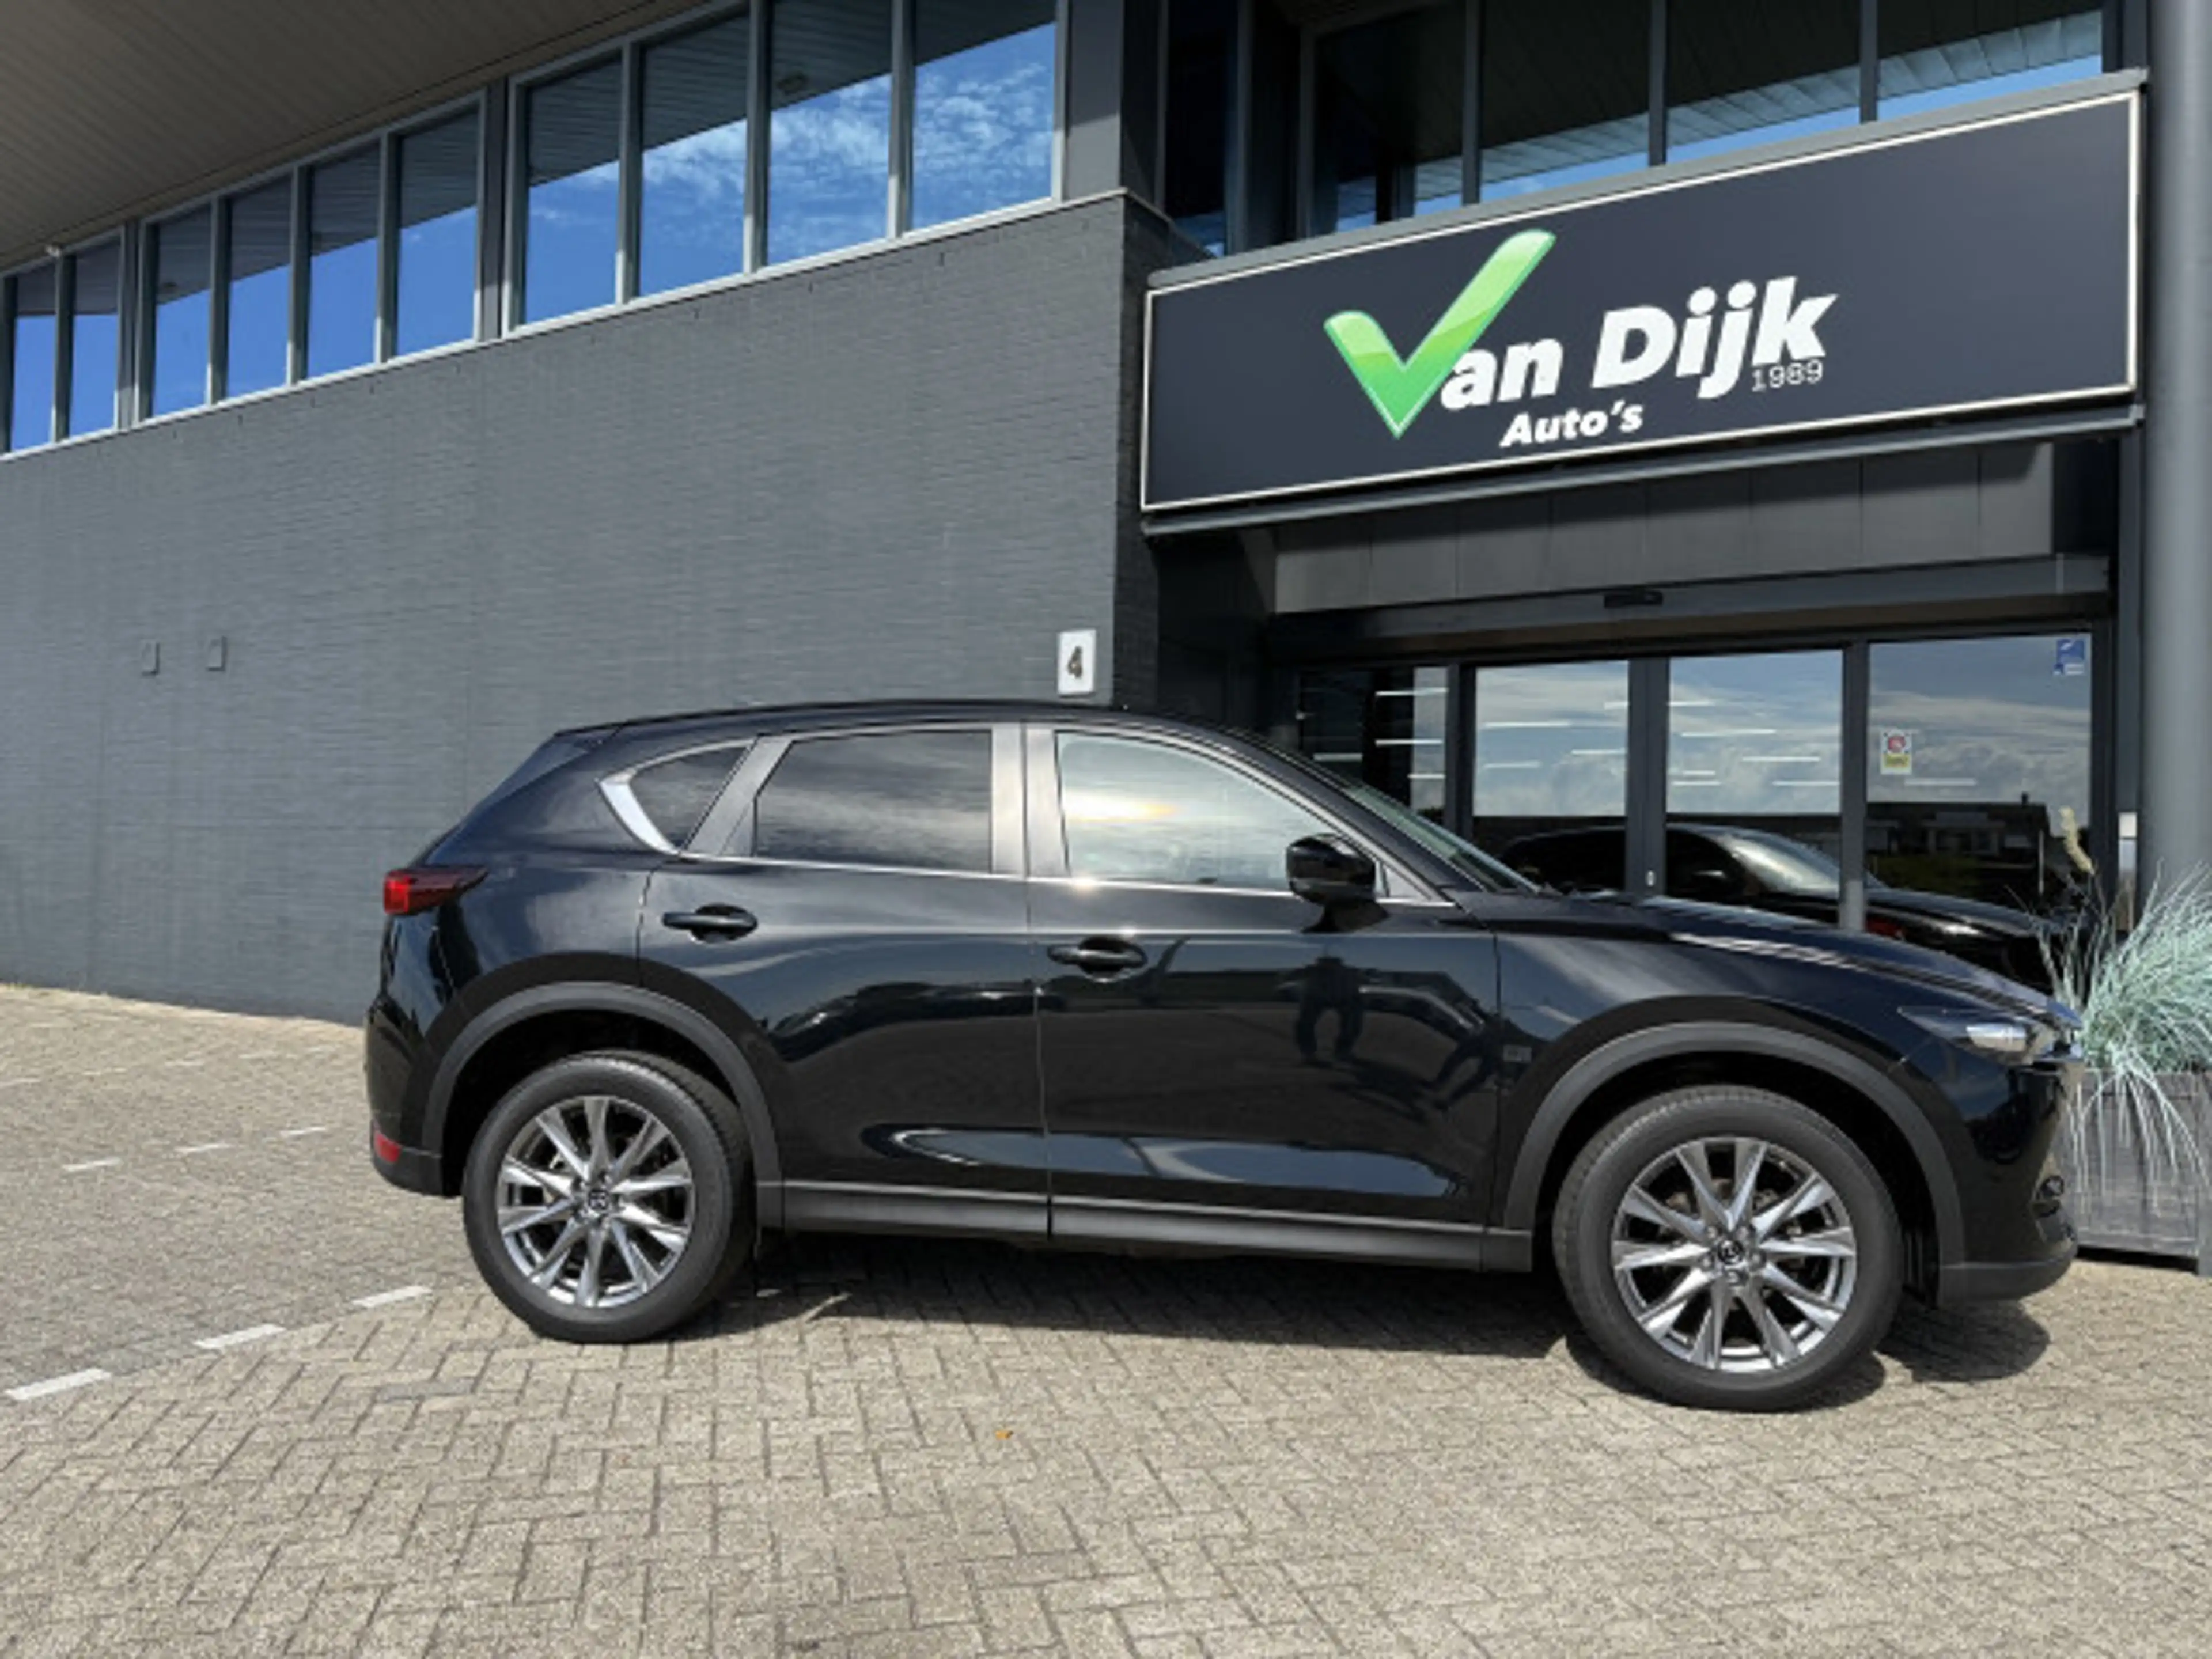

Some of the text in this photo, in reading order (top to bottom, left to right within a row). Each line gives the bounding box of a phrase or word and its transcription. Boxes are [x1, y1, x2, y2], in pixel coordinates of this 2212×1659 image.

[1591, 276, 1839, 399] Dijk
[1499, 399, 1644, 448] Auto's
[1067, 645, 1083, 680] 4
